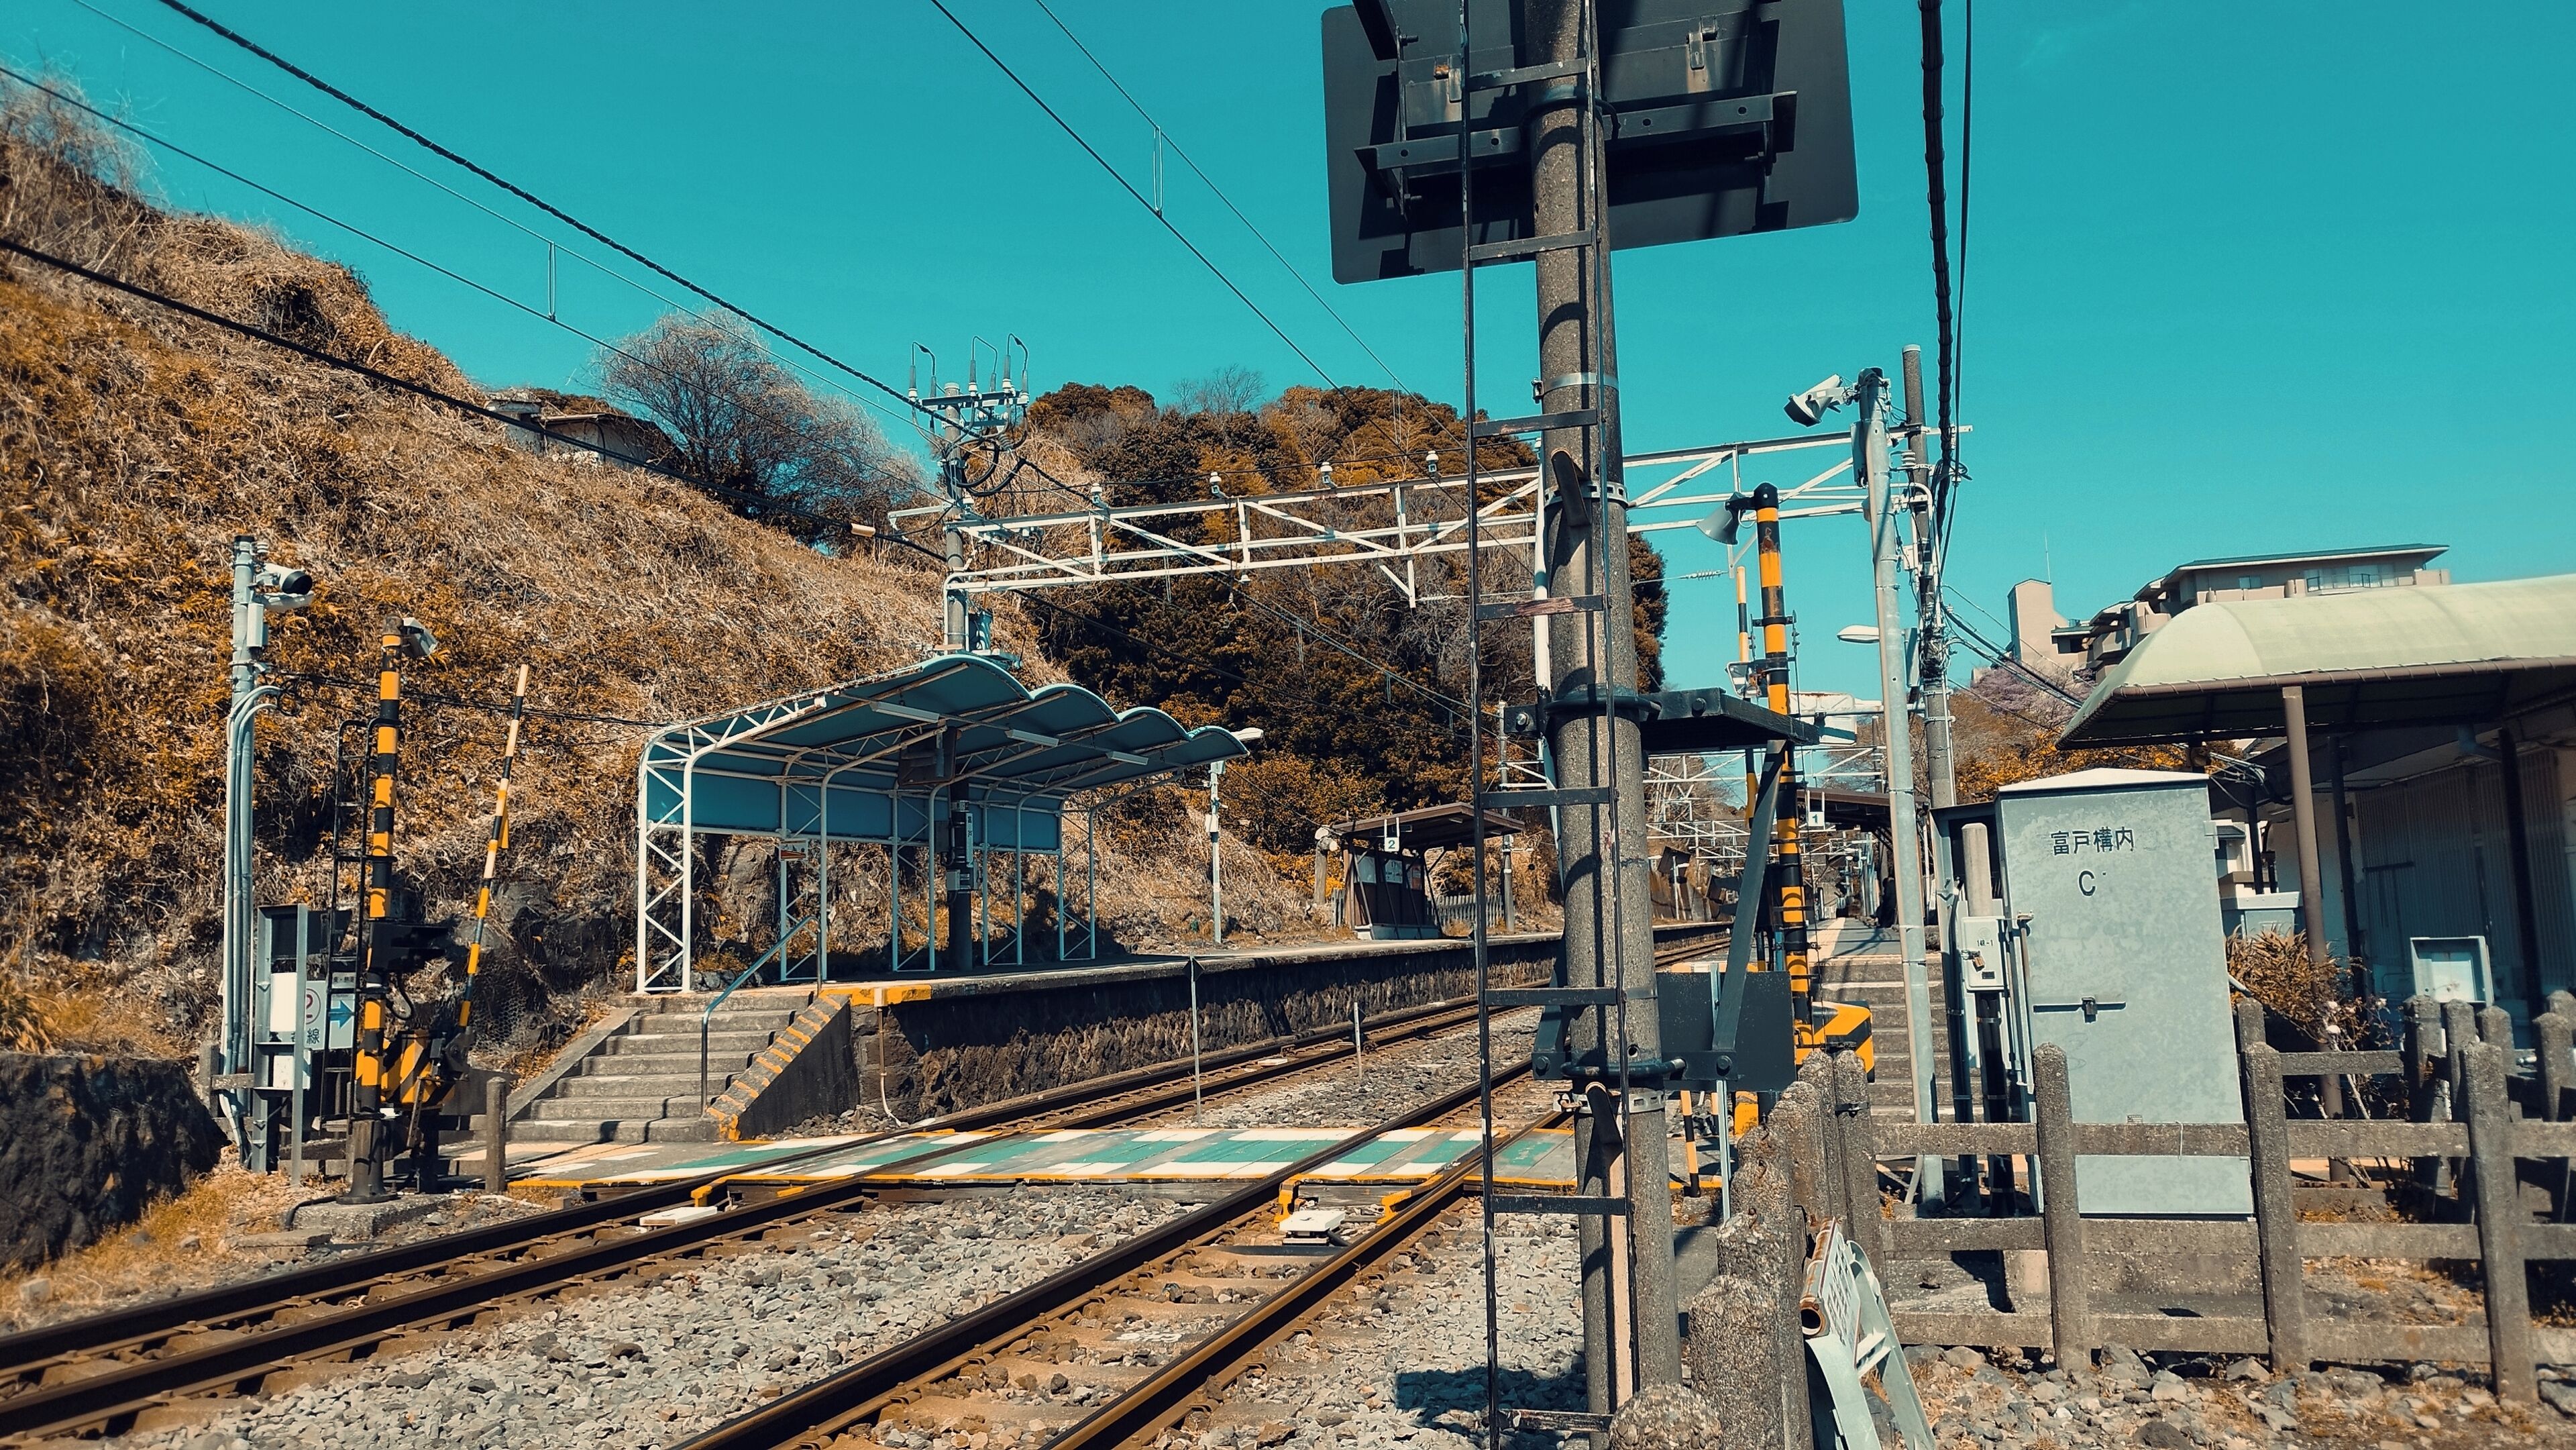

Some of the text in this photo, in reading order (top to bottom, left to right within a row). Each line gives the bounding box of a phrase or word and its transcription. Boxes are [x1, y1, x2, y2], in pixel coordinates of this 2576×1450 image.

[1813, 814, 1818, 825] 1
[1388, 840, 1395, 849] 2
[2051, 826, 2134, 856] 富戸構内
[2079, 870, 2096, 896] C
